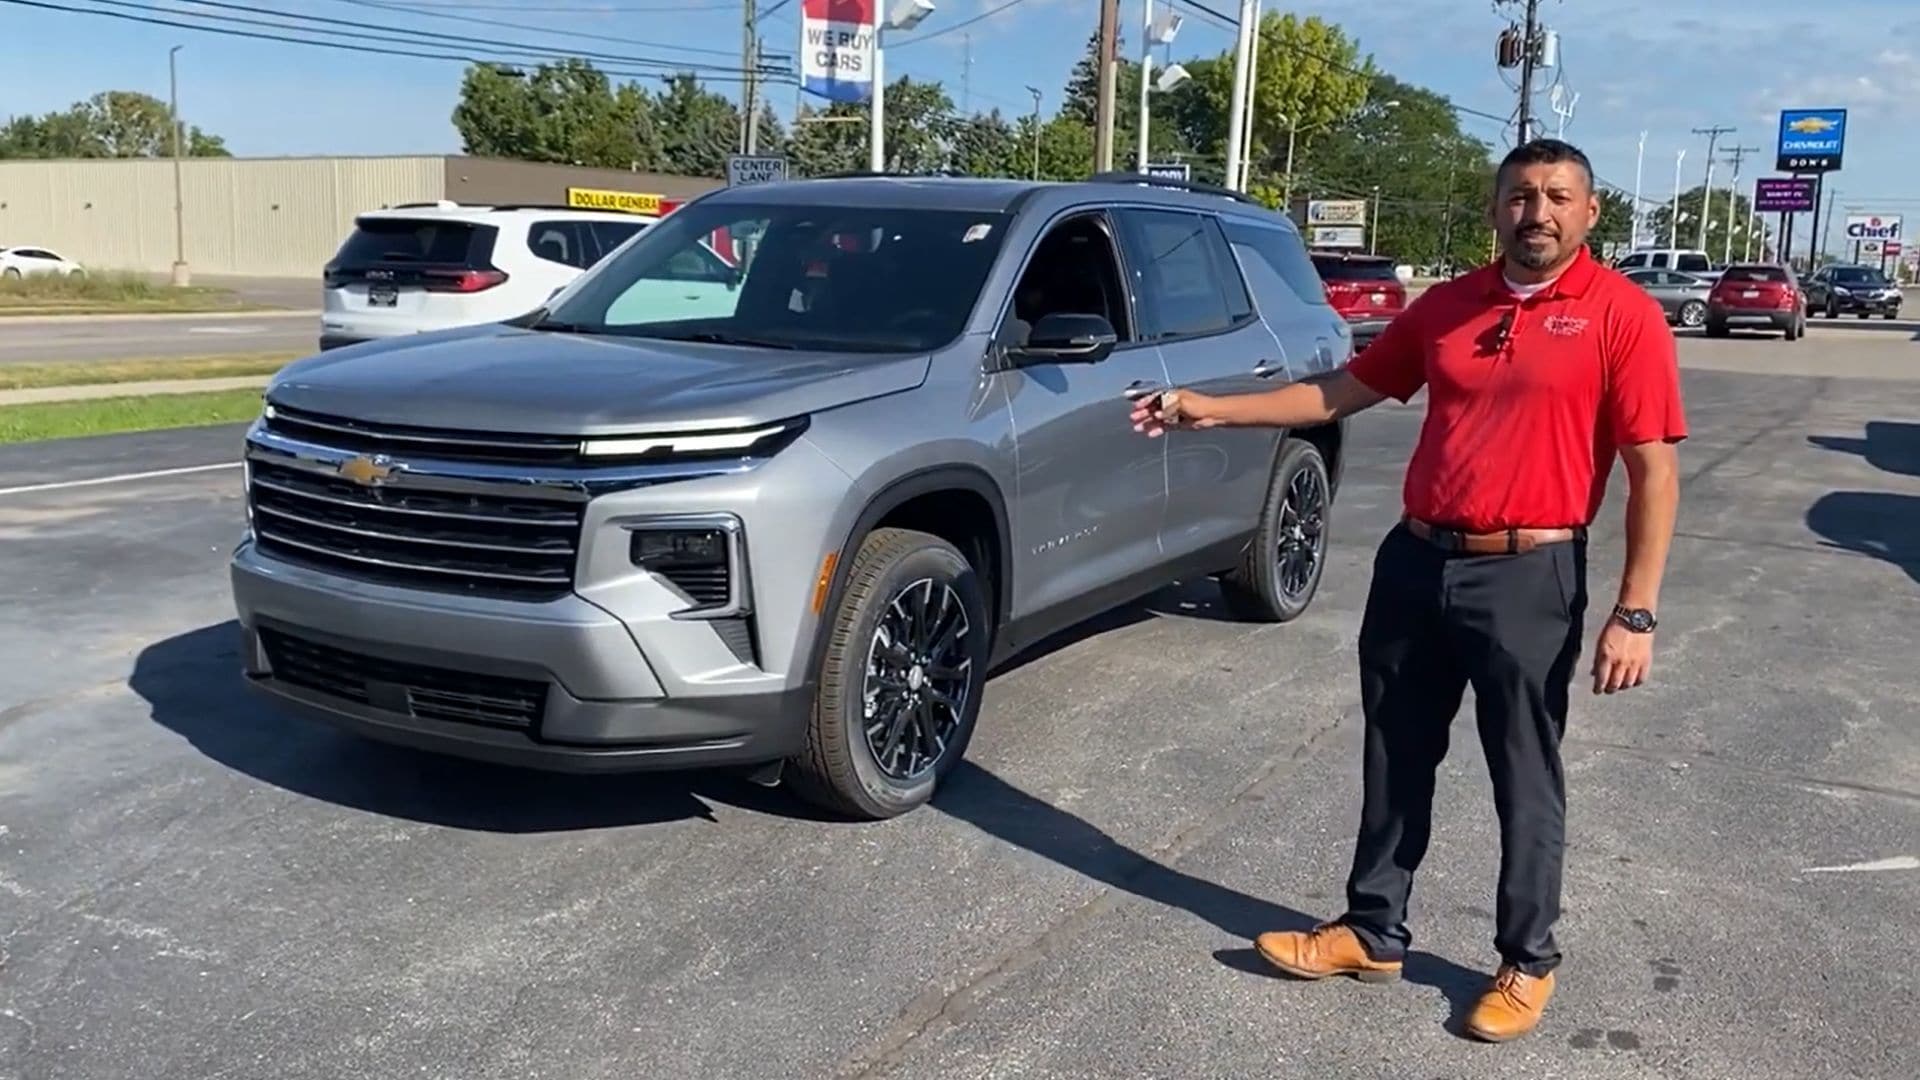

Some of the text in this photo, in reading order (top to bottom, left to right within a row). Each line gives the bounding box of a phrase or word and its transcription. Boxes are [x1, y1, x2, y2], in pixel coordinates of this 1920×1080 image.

[807, 28, 872, 50] WE BUY
[816, 51, 862, 71] CARS
[1783, 140, 1838, 149] CHEVROLET
[732, 160, 781, 171] CENTER
[575, 191, 658, 209] DOLLAR GENERA
[1847, 221, 1899, 237] Chief
